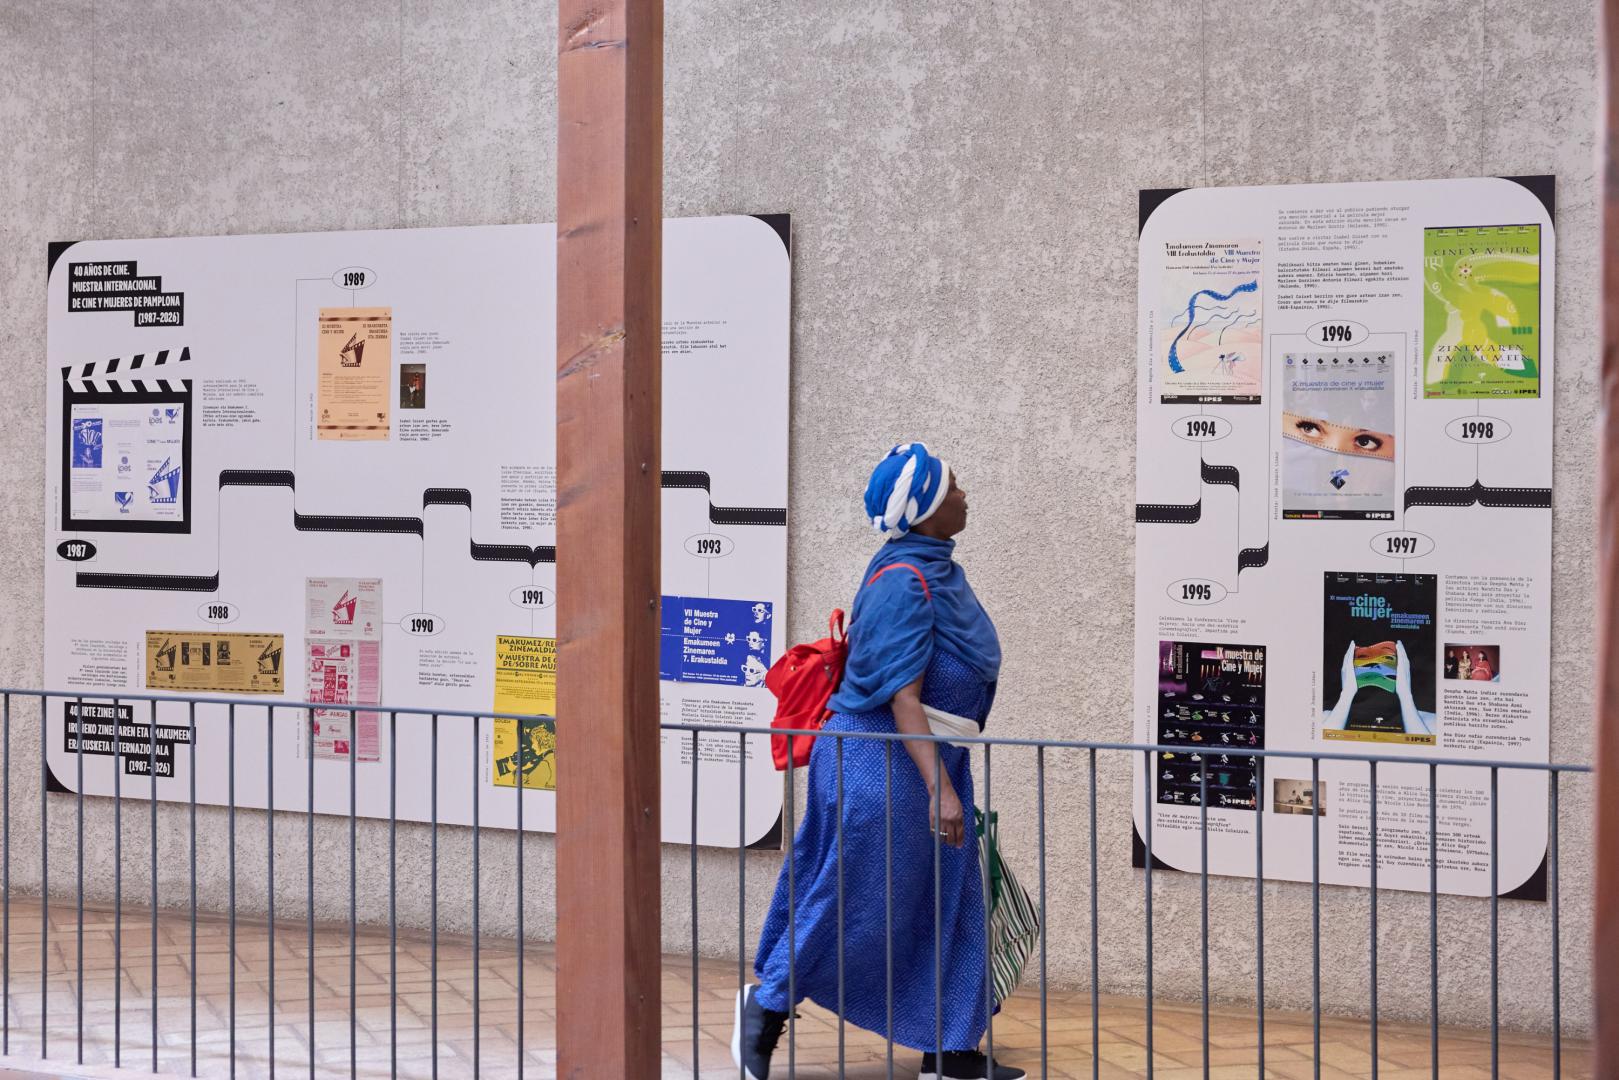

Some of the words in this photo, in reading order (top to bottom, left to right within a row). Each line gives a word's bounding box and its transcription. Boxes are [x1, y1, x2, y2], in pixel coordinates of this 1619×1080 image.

[74, 266, 82, 276] 40
[84, 263, 102, 276] AÑOS
[104, 265, 111, 275] DE
[113, 264, 130, 275] CINE.
[344, 272, 365, 286] 1989
[72, 281, 103, 292] MUESTRA
[104, 280, 156, 291] INTERNACIONAL
[72, 298, 80, 308] DE
[82, 298, 96, 308] CINE
[98, 298, 102, 308] Y
[104, 296, 132, 308] MUJERES
[134, 296, 142, 307] DE
[143, 296, 180, 307] PAMPLONA
[1322, 326, 1352, 342] 1996
[1187, 421, 1216, 436] 1994
[1462, 422, 1493, 438] 1998
[67, 544, 86, 558] 1987
[697, 540, 721, 554] 1993
[1386, 537, 1417, 554] 1997
[522, 591, 544, 604] 1991
[1182, 584, 1211, 600] 1995
[1356, 594, 1385, 607] cine
[208, 606, 228, 619] 1988
[694, 609, 718, 618] Muestra
[1351, 606, 1392, 620] mujer
[411, 619, 434, 632] 1990
[684, 626, 702, 635] Mujer
[684, 638, 720, 646] Emakumeen
[683, 646, 715, 655] Zinemaren
[1216, 647, 1224, 659] IX
[1225, 648, 1253, 660] muestra
[1254, 648, 1263, 660] de
[691, 655, 728, 665] Erakustaldia
[1221, 660, 1236, 671] Cine
[1238, 662, 1242, 674] y
[1244, 661, 1263, 674] Mujer
[70, 705, 78, 716] 40
[137, 727, 148, 738] ETA
[111, 742, 169, 756] ITERNAZIOALA
[129, 760, 170, 775] (1987-026)
